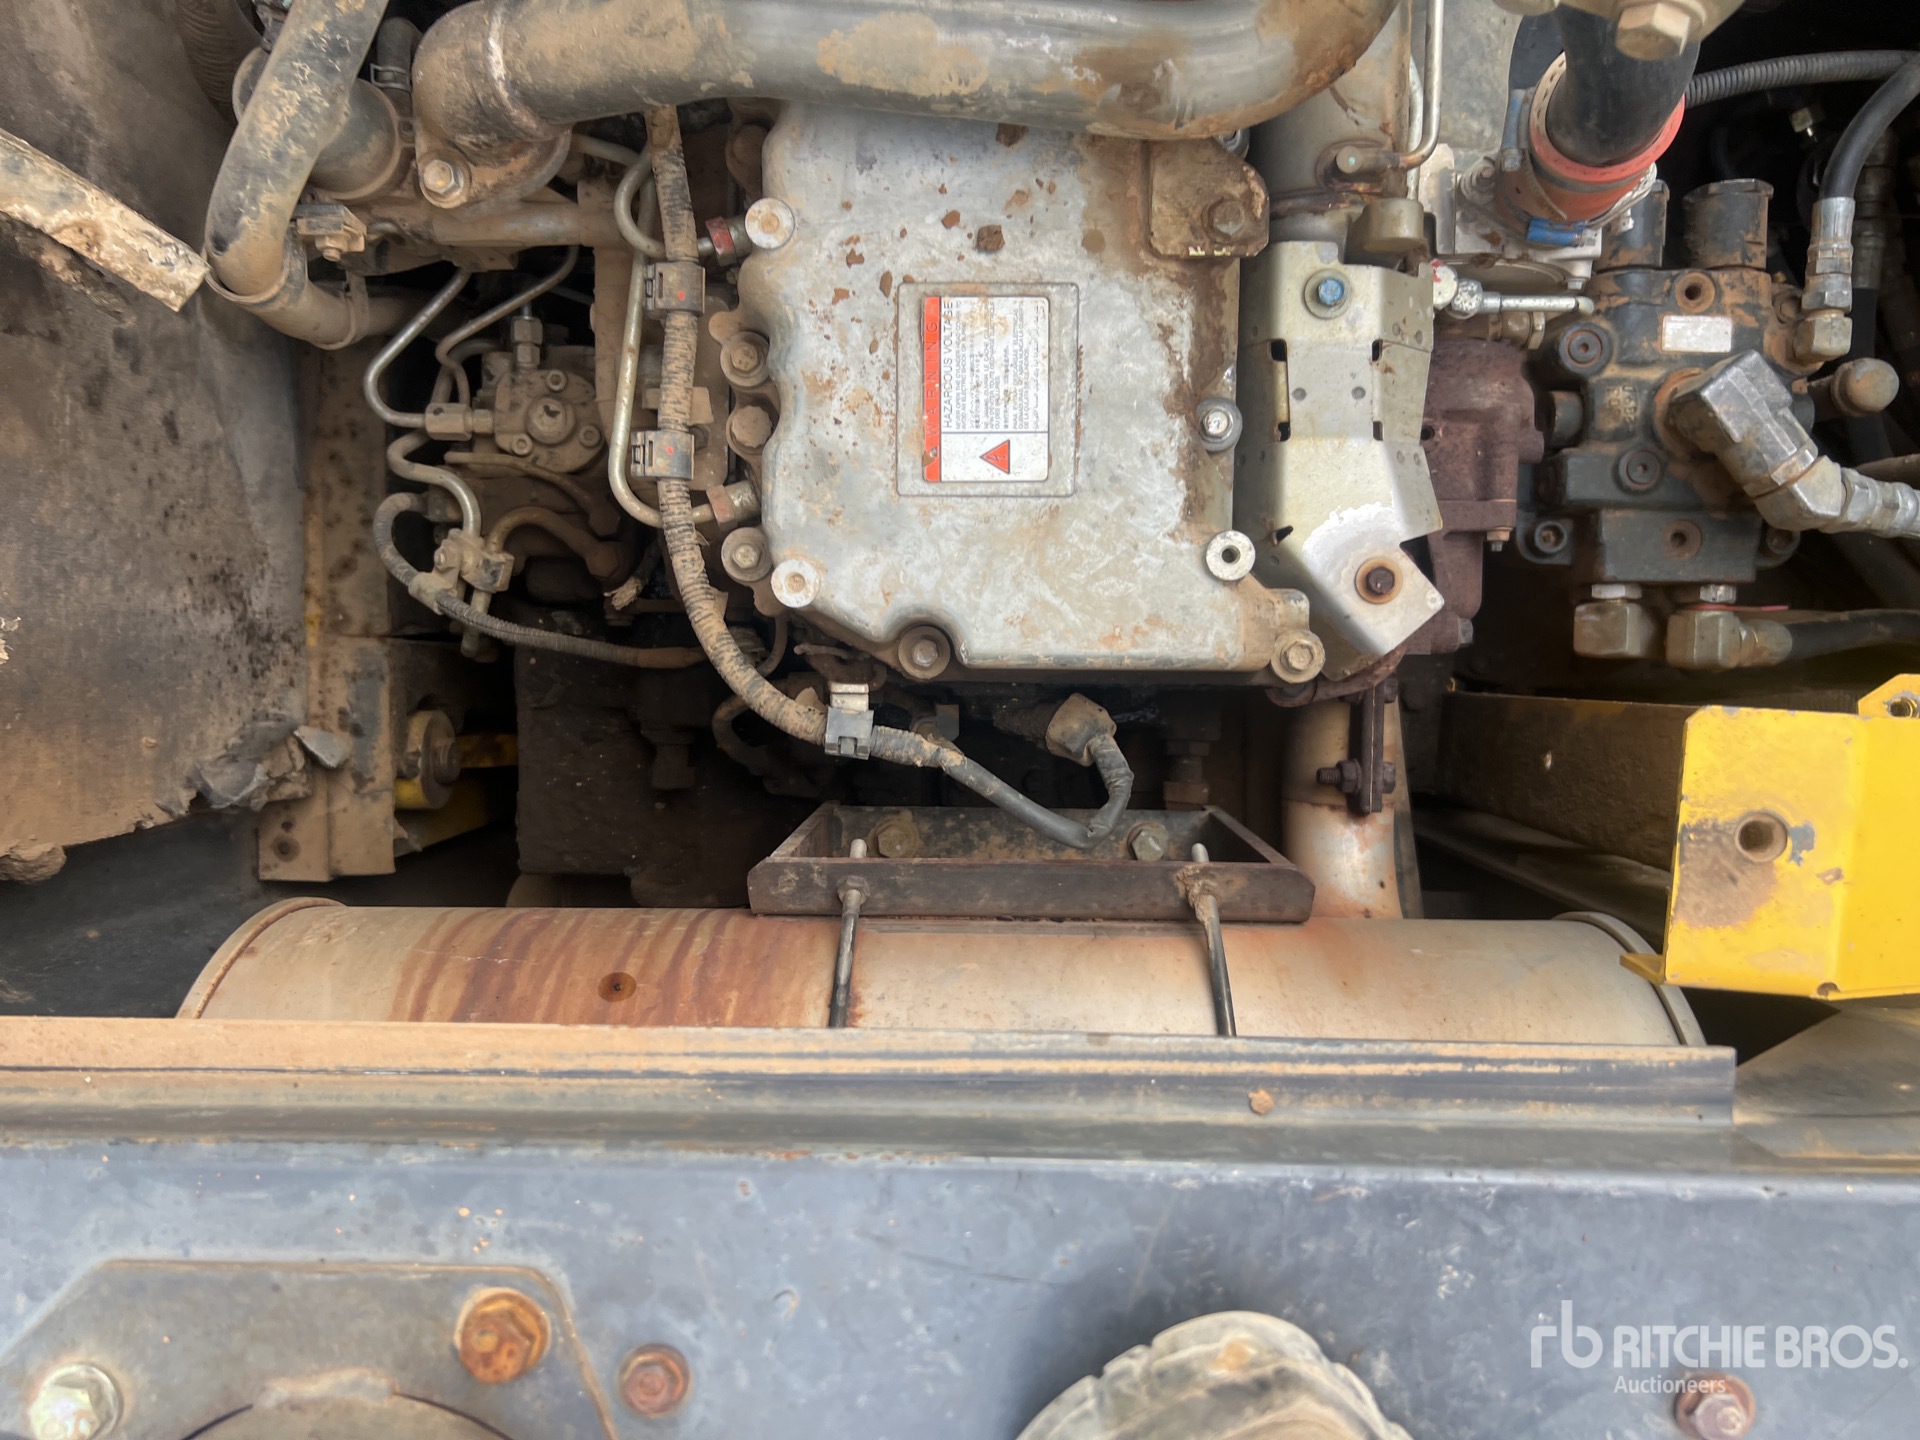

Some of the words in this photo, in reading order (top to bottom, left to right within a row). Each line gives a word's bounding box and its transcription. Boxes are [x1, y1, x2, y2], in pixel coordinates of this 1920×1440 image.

[944, 302, 953, 353] VOLTAGE
[926, 321, 937, 436] WARNING
[944, 357, 953, 428] HAZARDOUS
